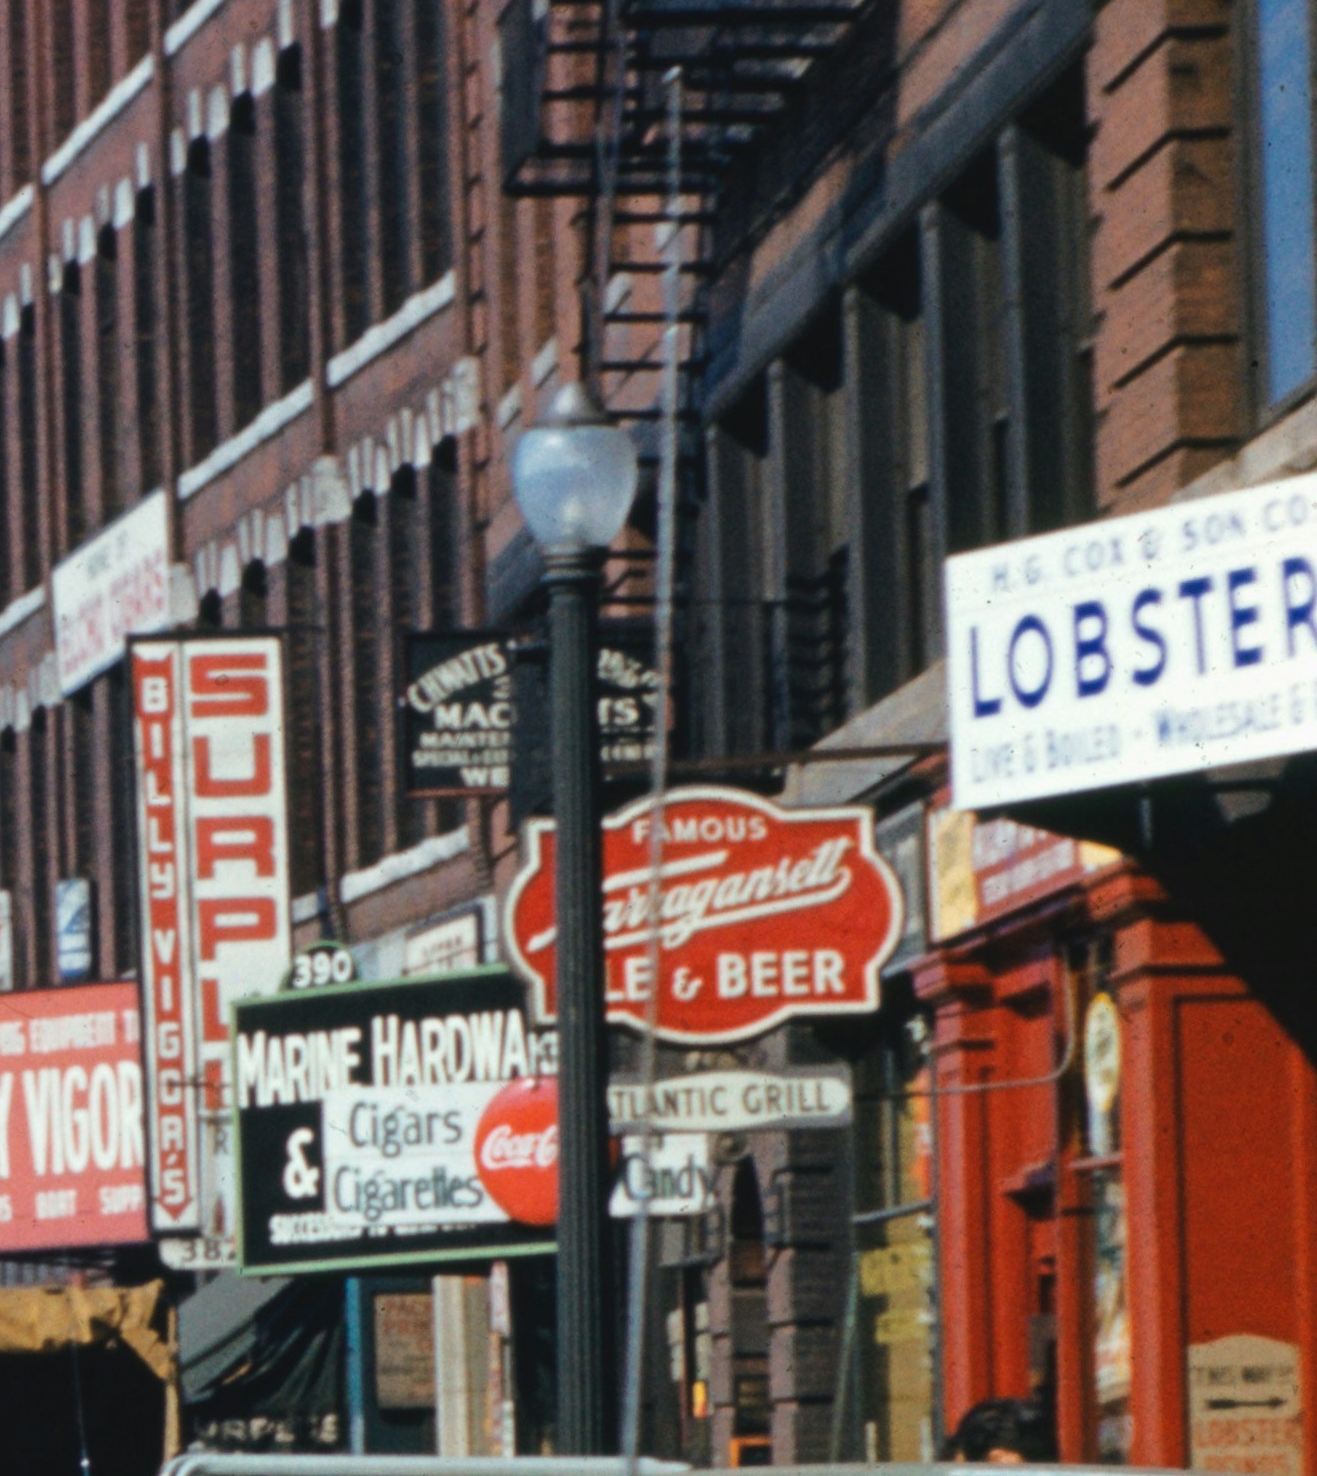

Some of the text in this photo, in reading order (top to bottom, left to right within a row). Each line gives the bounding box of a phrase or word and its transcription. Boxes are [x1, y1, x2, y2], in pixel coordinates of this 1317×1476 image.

[969, 556, 1317, 719] LOBSTER
[141, 676, 174, 900] BILLY
[632, 816, 769, 845] FAMOUS
[291, 951, 353, 990] 390
[605, 950, 845, 1002] LE & BEER
[236, 1027, 362, 1109] MARINE
[348, 1101, 464, 1159] Cigars
[611, 1082, 831, 1120] TLANTIC GRILL
[283, 1127, 320, 1199] &
[334, 1164, 485, 1222] Cigarettes
